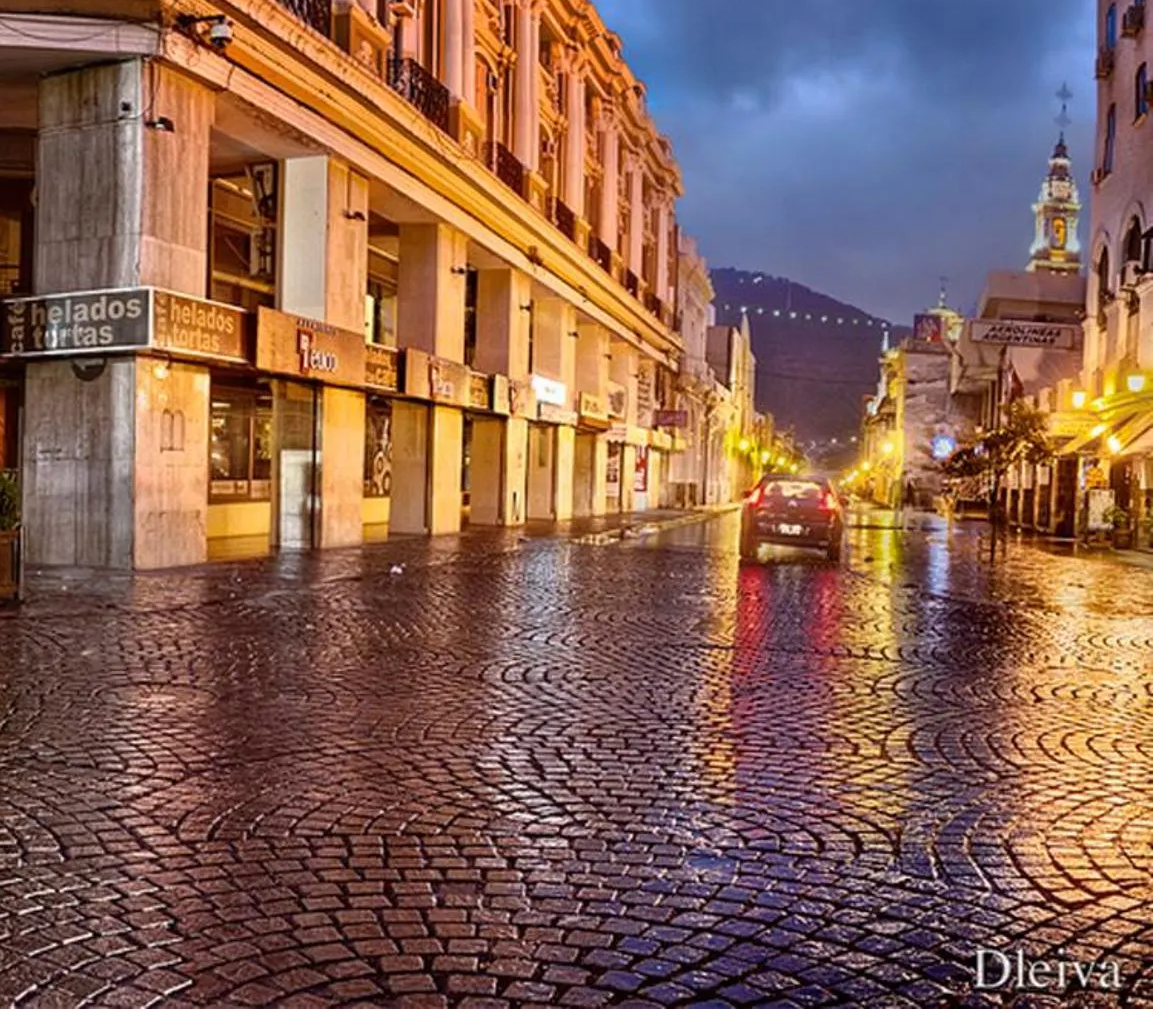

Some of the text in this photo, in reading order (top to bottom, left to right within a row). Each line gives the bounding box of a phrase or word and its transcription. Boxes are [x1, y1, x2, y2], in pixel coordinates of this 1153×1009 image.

[30, 295, 142, 326] helados
[170, 296, 235, 334] helados
[33, 324, 114, 349] tortas
[172, 323, 221, 352] tortas
